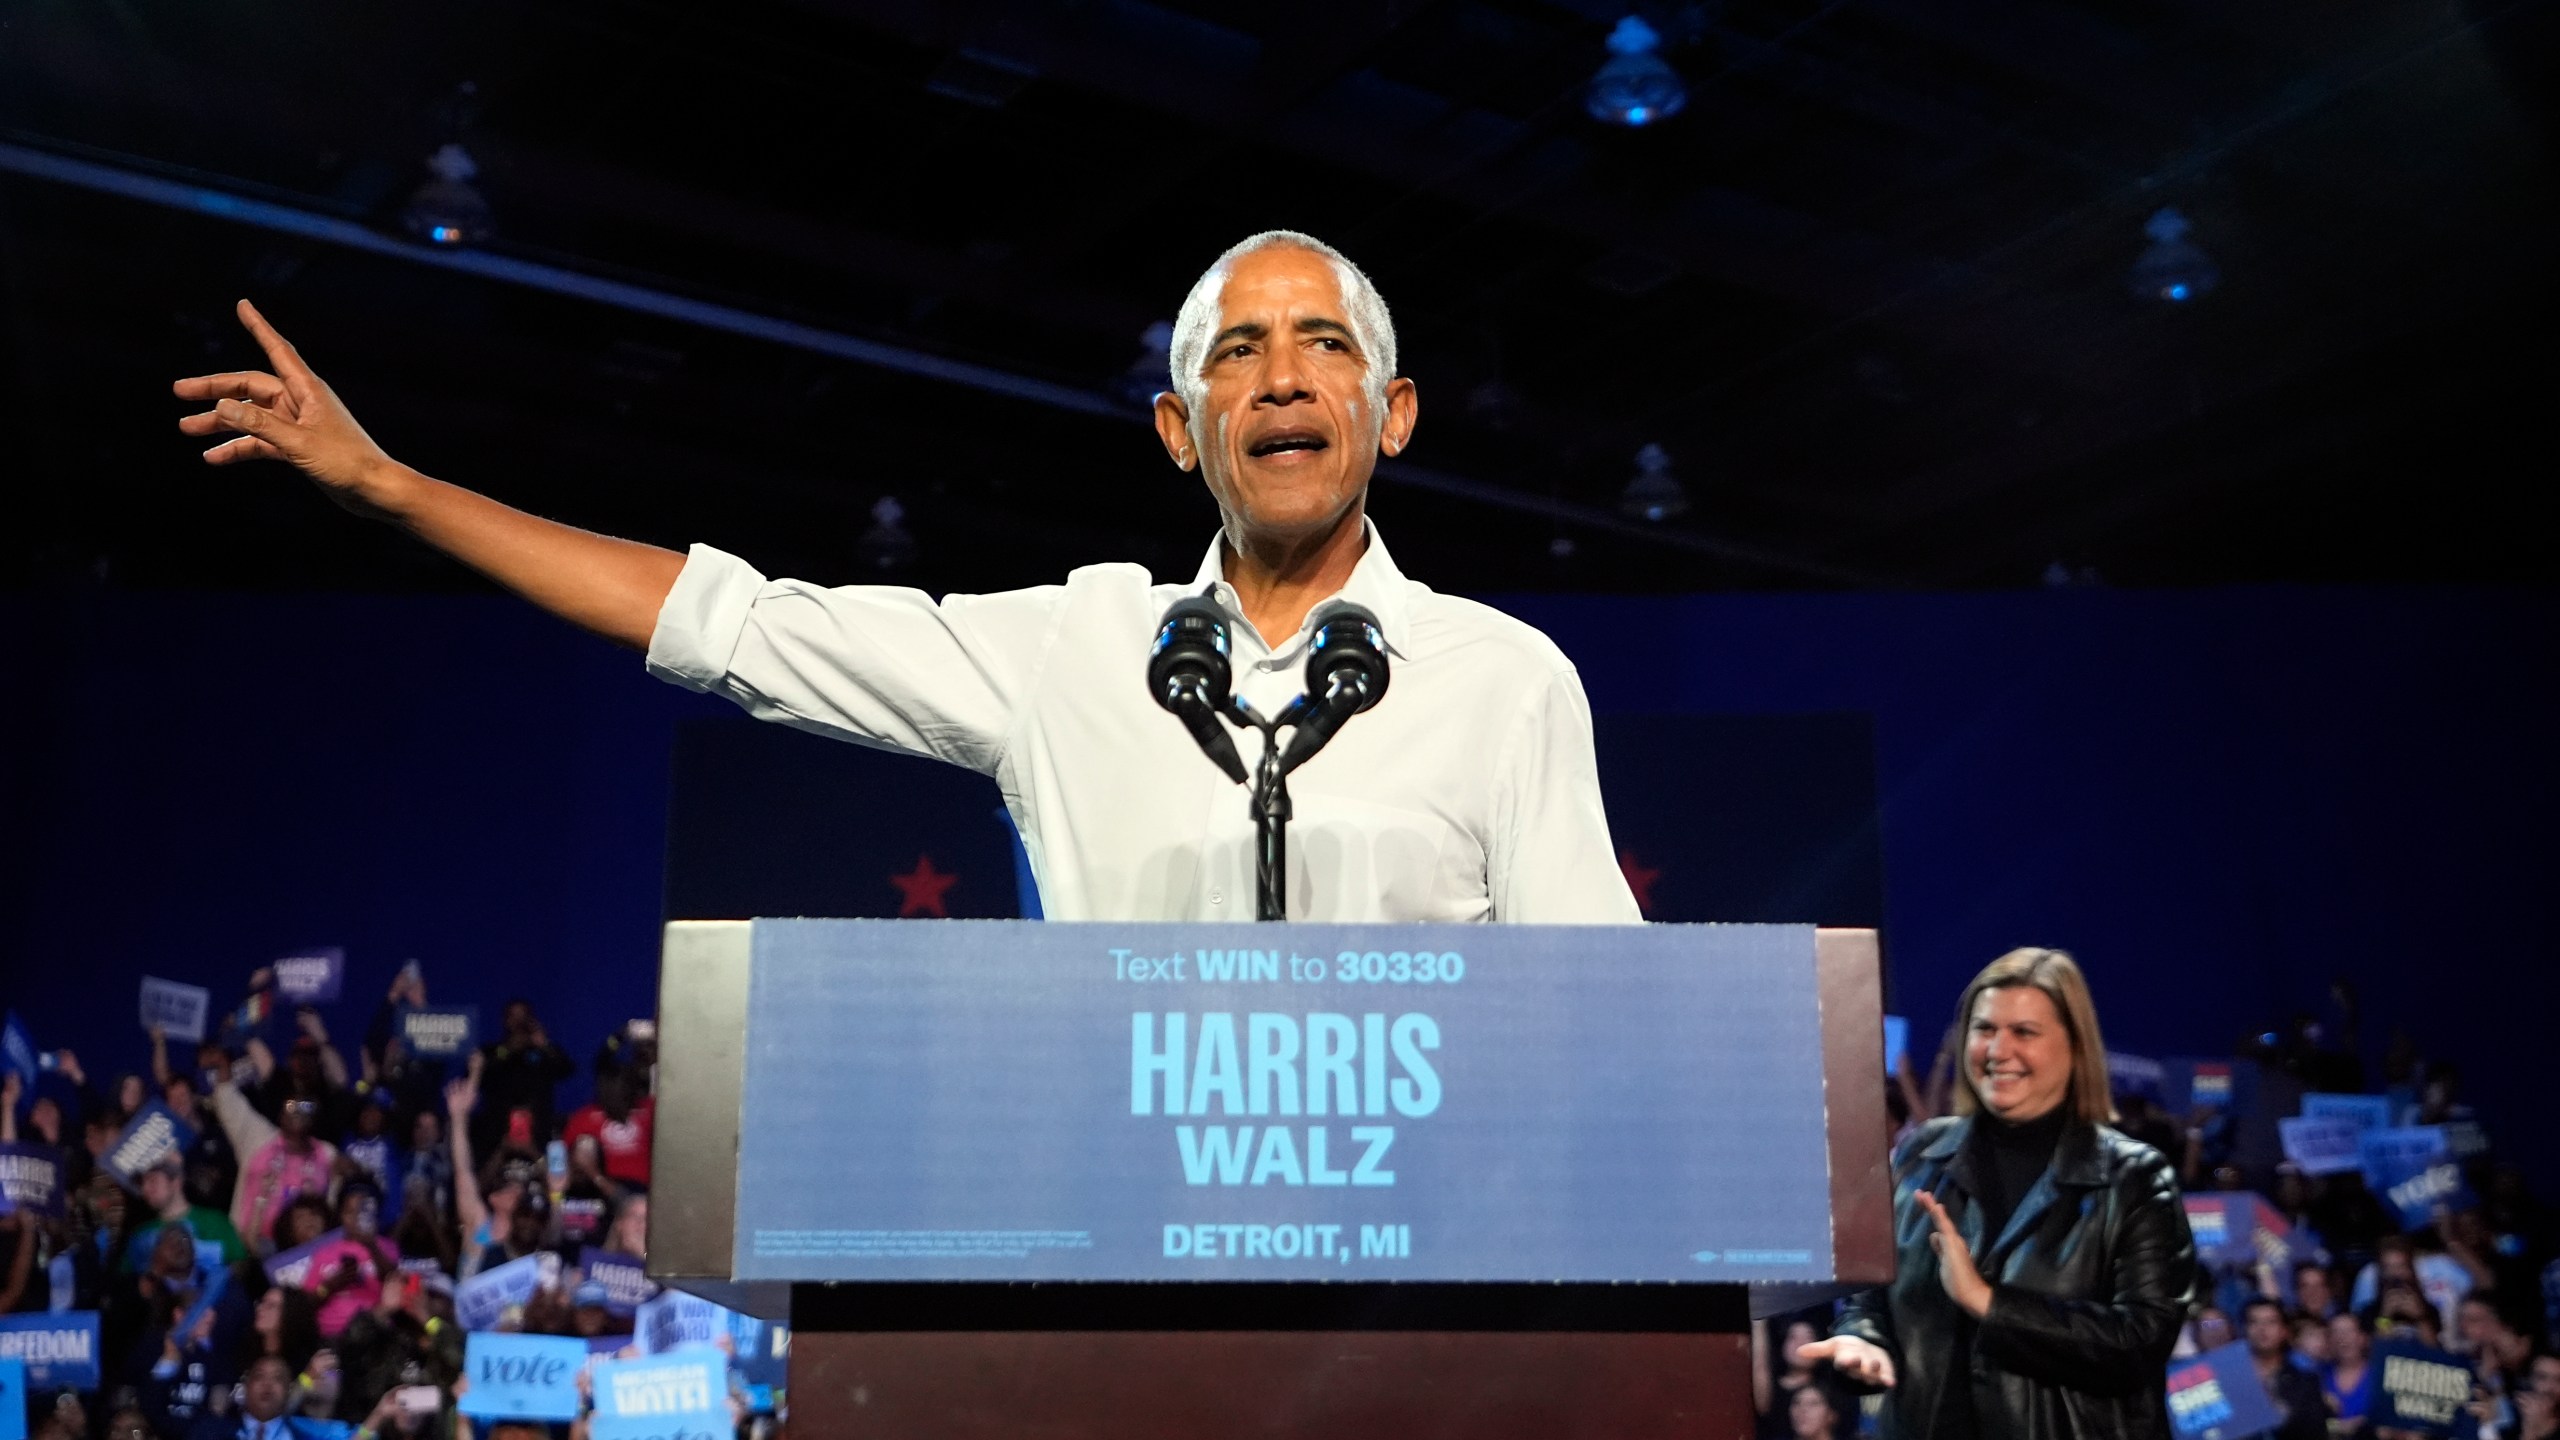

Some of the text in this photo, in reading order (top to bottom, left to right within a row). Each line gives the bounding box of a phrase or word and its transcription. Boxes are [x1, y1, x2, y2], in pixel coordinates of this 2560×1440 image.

[1109, 949, 1466, 984] Text WIN to 30330
[1131, 1011, 1443, 1118] HARRIS
[1175, 1125, 1396, 1186] WALZ
[1163, 1225, 1410, 1264] DETROIT, MI
[480, 1353, 567, 1386] vote
[2383, 1354, 2472, 1402] HARRIS
